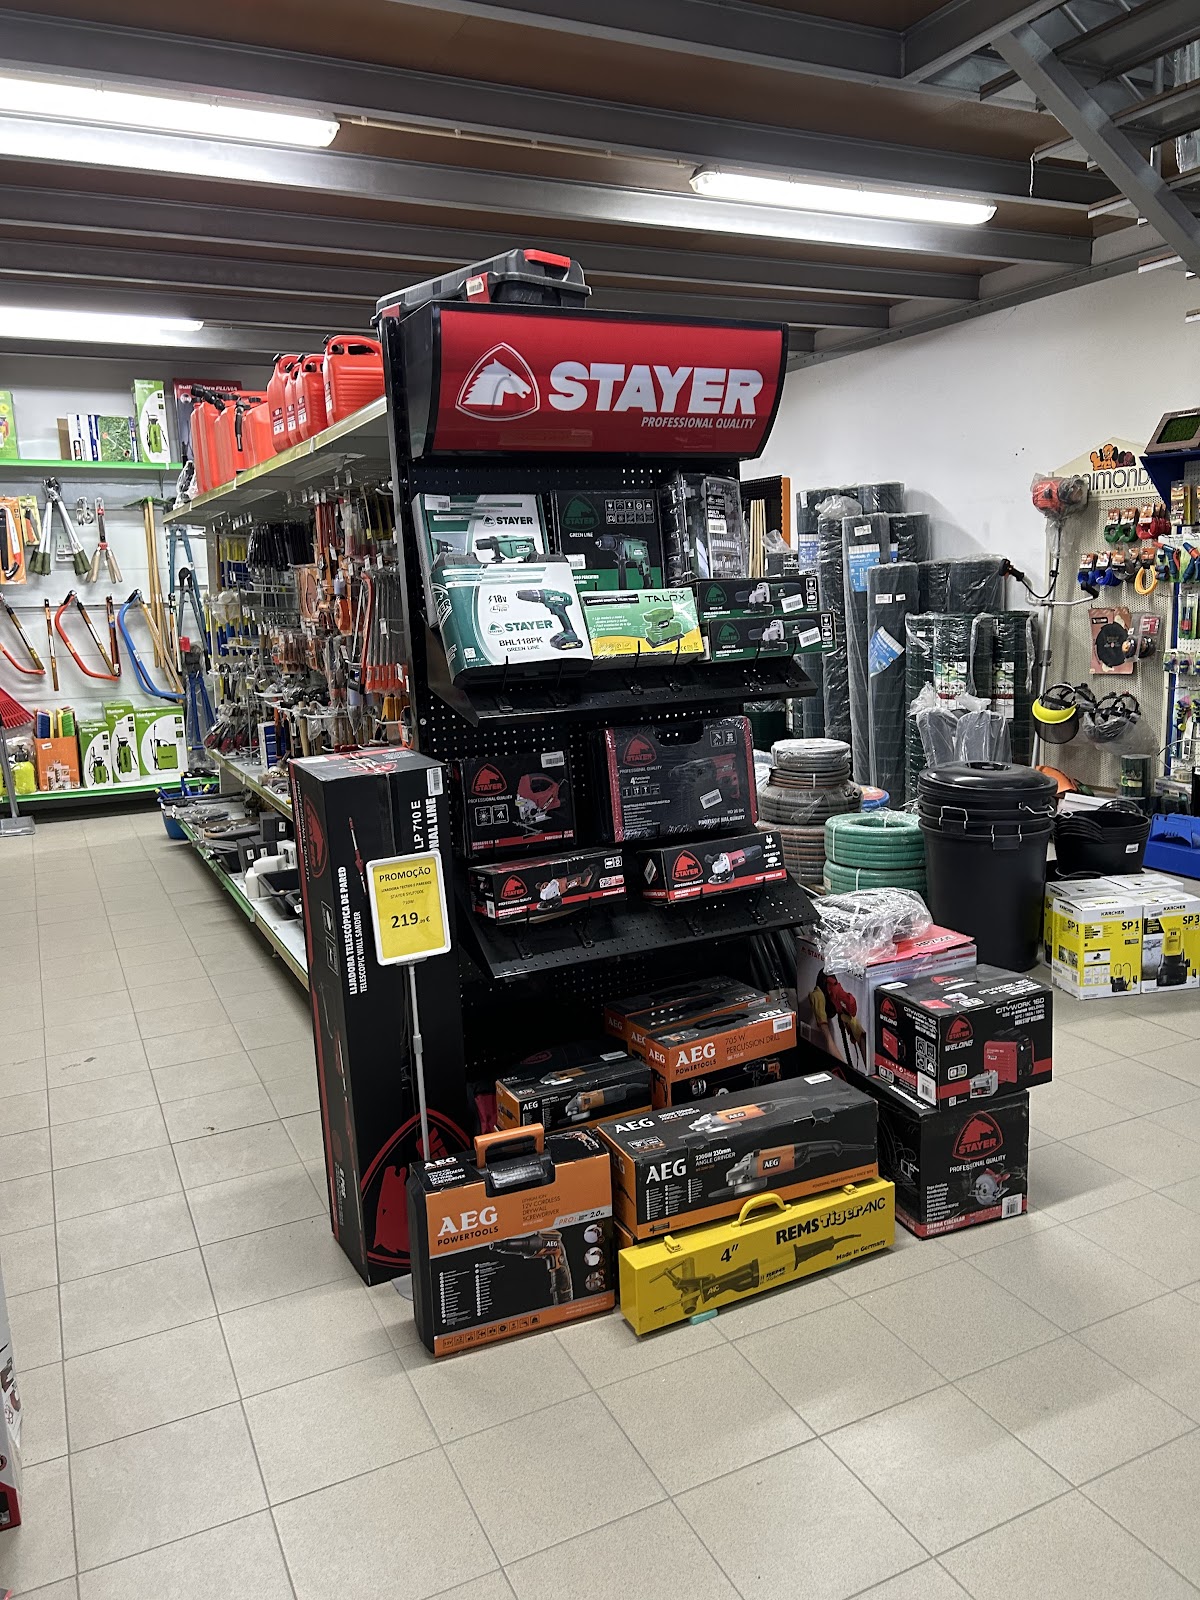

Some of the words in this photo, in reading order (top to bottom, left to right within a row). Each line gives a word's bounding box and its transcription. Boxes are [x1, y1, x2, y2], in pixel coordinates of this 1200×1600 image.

[548, 361, 764, 414] STAYER
[641, 416, 714, 429] PROFESSIONAL
[715, 418, 756, 429] QUALITY
[497, 517, 533, 525] STAYER
[566, 517, 594, 525] STAYER
[645, 594, 686, 602] TALOX
[505, 620, 553, 632] STAYER
[499, 637, 544, 647] BHL118PK
[475, 783, 502, 792] STAYER
[411, 800, 421, 810] E
[425, 797, 438, 824] LINE
[412, 811, 423, 833] 710
[413, 834, 424, 850] LP
[379, 866, 431, 882] PROMOÇÃO
[675, 868, 699, 877] STAYER
[338, 866, 350, 893] PARED
[503, 888, 524, 896] STAYER
[341, 893, 349, 905] DE
[354, 911, 362, 937] SANDER
[1121, 921, 1134, 930] SP
[1135, 920, 1139, 929] 1
[1183, 915, 1194, 925] SP
[1195, 914, 1200, 924] 3
[341, 905, 354, 955] TELESCÓPICA
[1068, 920, 1075, 929] SP
[1075, 924, 1079, 933] 1
[356, 937, 364, 955] WALL
[346, 955, 357, 995] LIJADORA
[357, 955, 367, 993] TELESCOPIC
[996, 1001, 1031, 1014] CITYWORK
[608, 1017, 623, 1030] AEG
[725, 1036, 737, 1045] 705
[739, 1033, 746, 1041] W
[949, 1031, 970, 1039] STAYER
[726, 1040, 765, 1054] PERCUSSION
[766, 1034, 780, 1045] DRILL
[945, 1039, 973, 1051] WELDING
[649, 1048, 665, 1064] AEG
[676, 1042, 716, 1067] AEG
[675, 1060, 717, 1075] POWERTOOLS
[523, 1101, 538, 1111] AEG
[615, 1118, 655, 1133] AEG
[958, 1138, 997, 1154] STAYER
[424, 1156, 457, 1169] AEG
[695, 1158, 713, 1167] ANGLE
[714, 1152, 736, 1162] GRINDER
[764, 1158, 779, 1169] AEG
[949, 1160, 985, 1173] PROFESSIONAL
[986, 1154, 1006, 1165] QUALITY
[646, 1158, 687, 1184] AEG
[534, 1196, 560, 1206] CORDLESS
[523, 1206, 547, 1215] DRYWALL
[523, 1209, 559, 1222] SCREWDRIVER
[590, 1210, 601, 1218] 2.0
[437, 1206, 498, 1237] AEG
[927, 1221, 943, 1230] SIERRA
[944, 1216, 966, 1225] CIRCULAR
[437, 1226, 499, 1246] POWERTOOLS
[775, 1218, 820, 1245] REMS
[836, 1250, 852, 1261] Made
[860, 1239, 886, 1253] Germany
